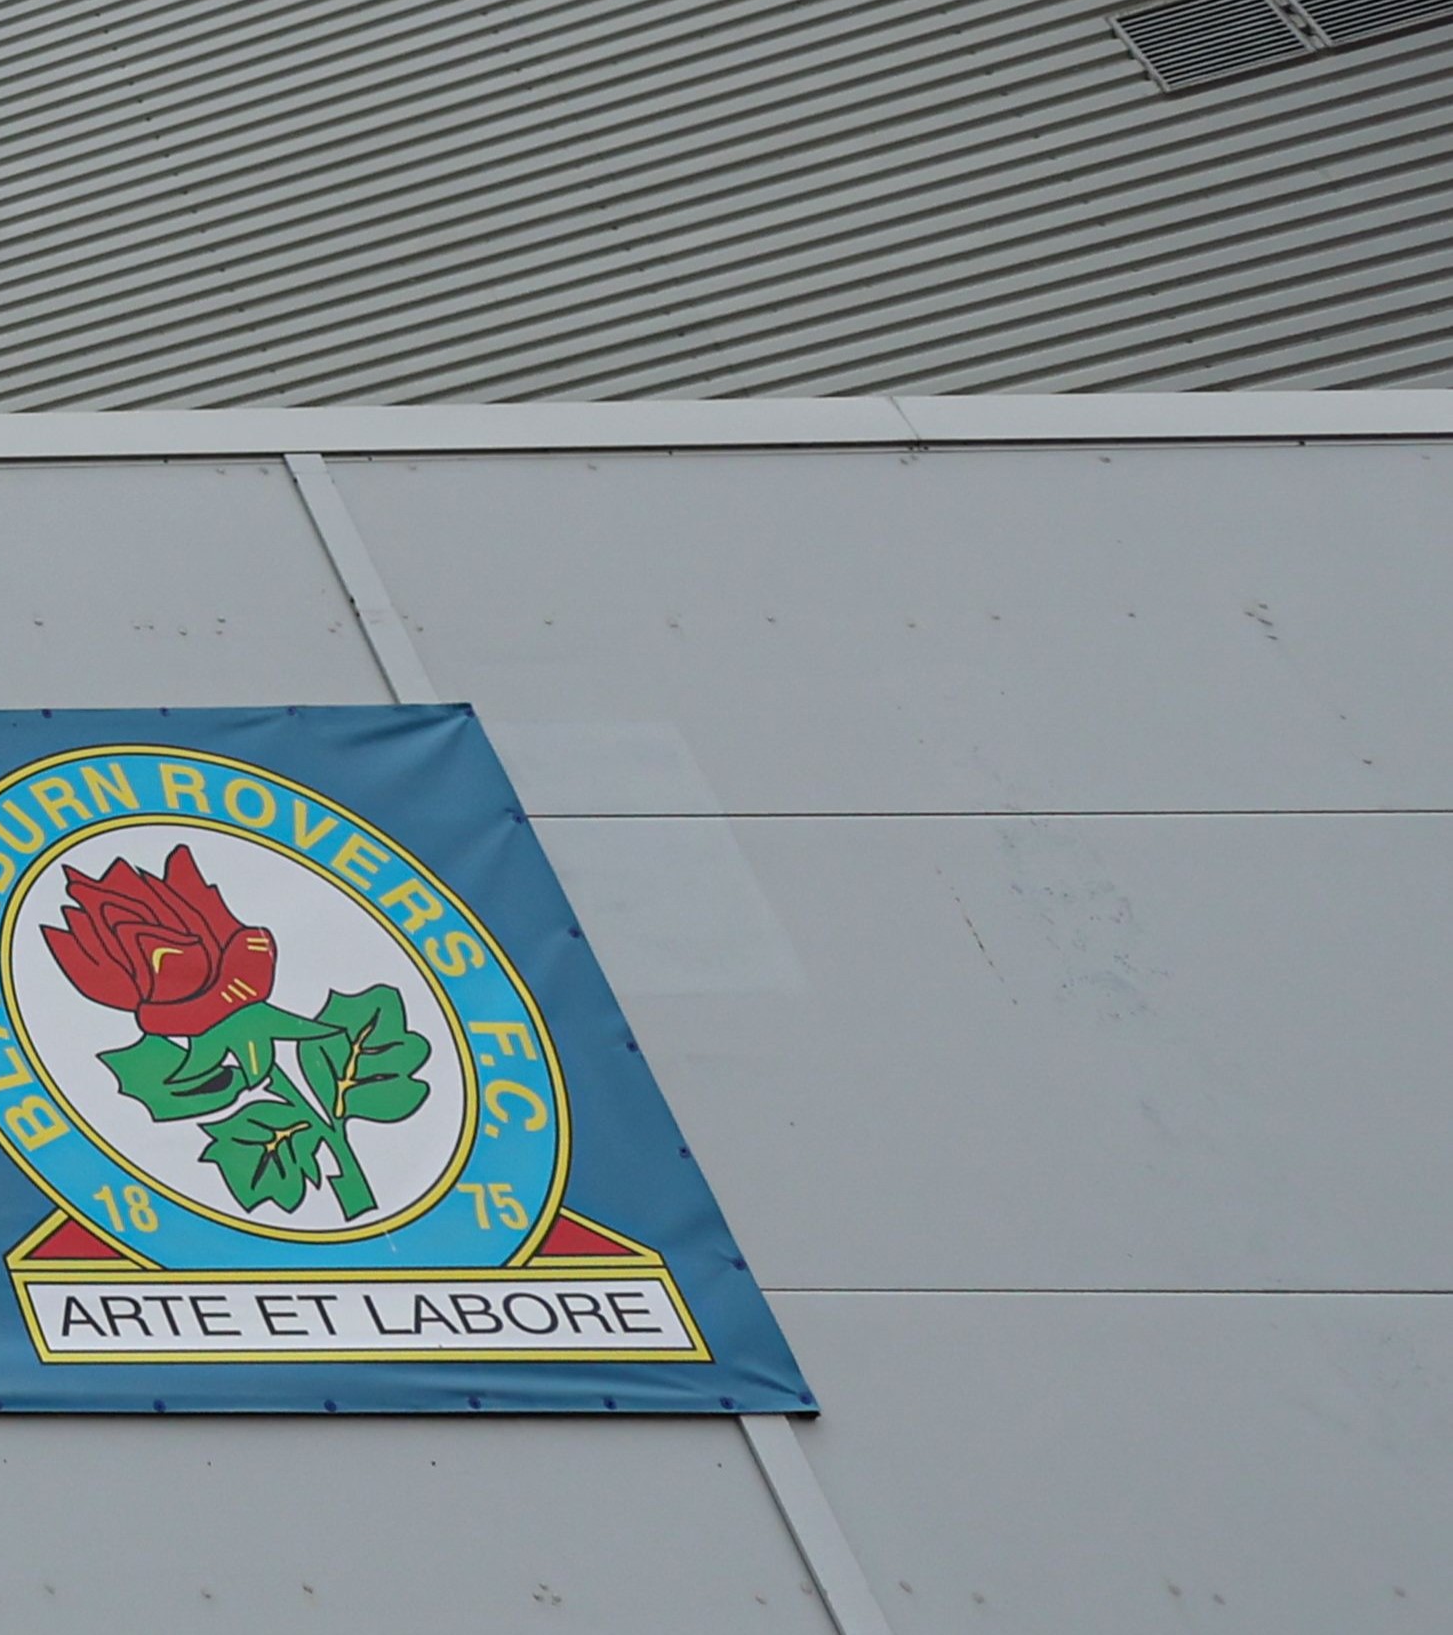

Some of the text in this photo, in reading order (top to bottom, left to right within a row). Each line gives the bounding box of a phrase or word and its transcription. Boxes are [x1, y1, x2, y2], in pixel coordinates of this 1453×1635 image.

[162, 764, 484, 977] ROVERS
[469, 1022, 548, 1138] F.C.
[94, 1183, 528, 1233] 18 75
[60, 1292, 662, 1337] ARTE ET LABORE
